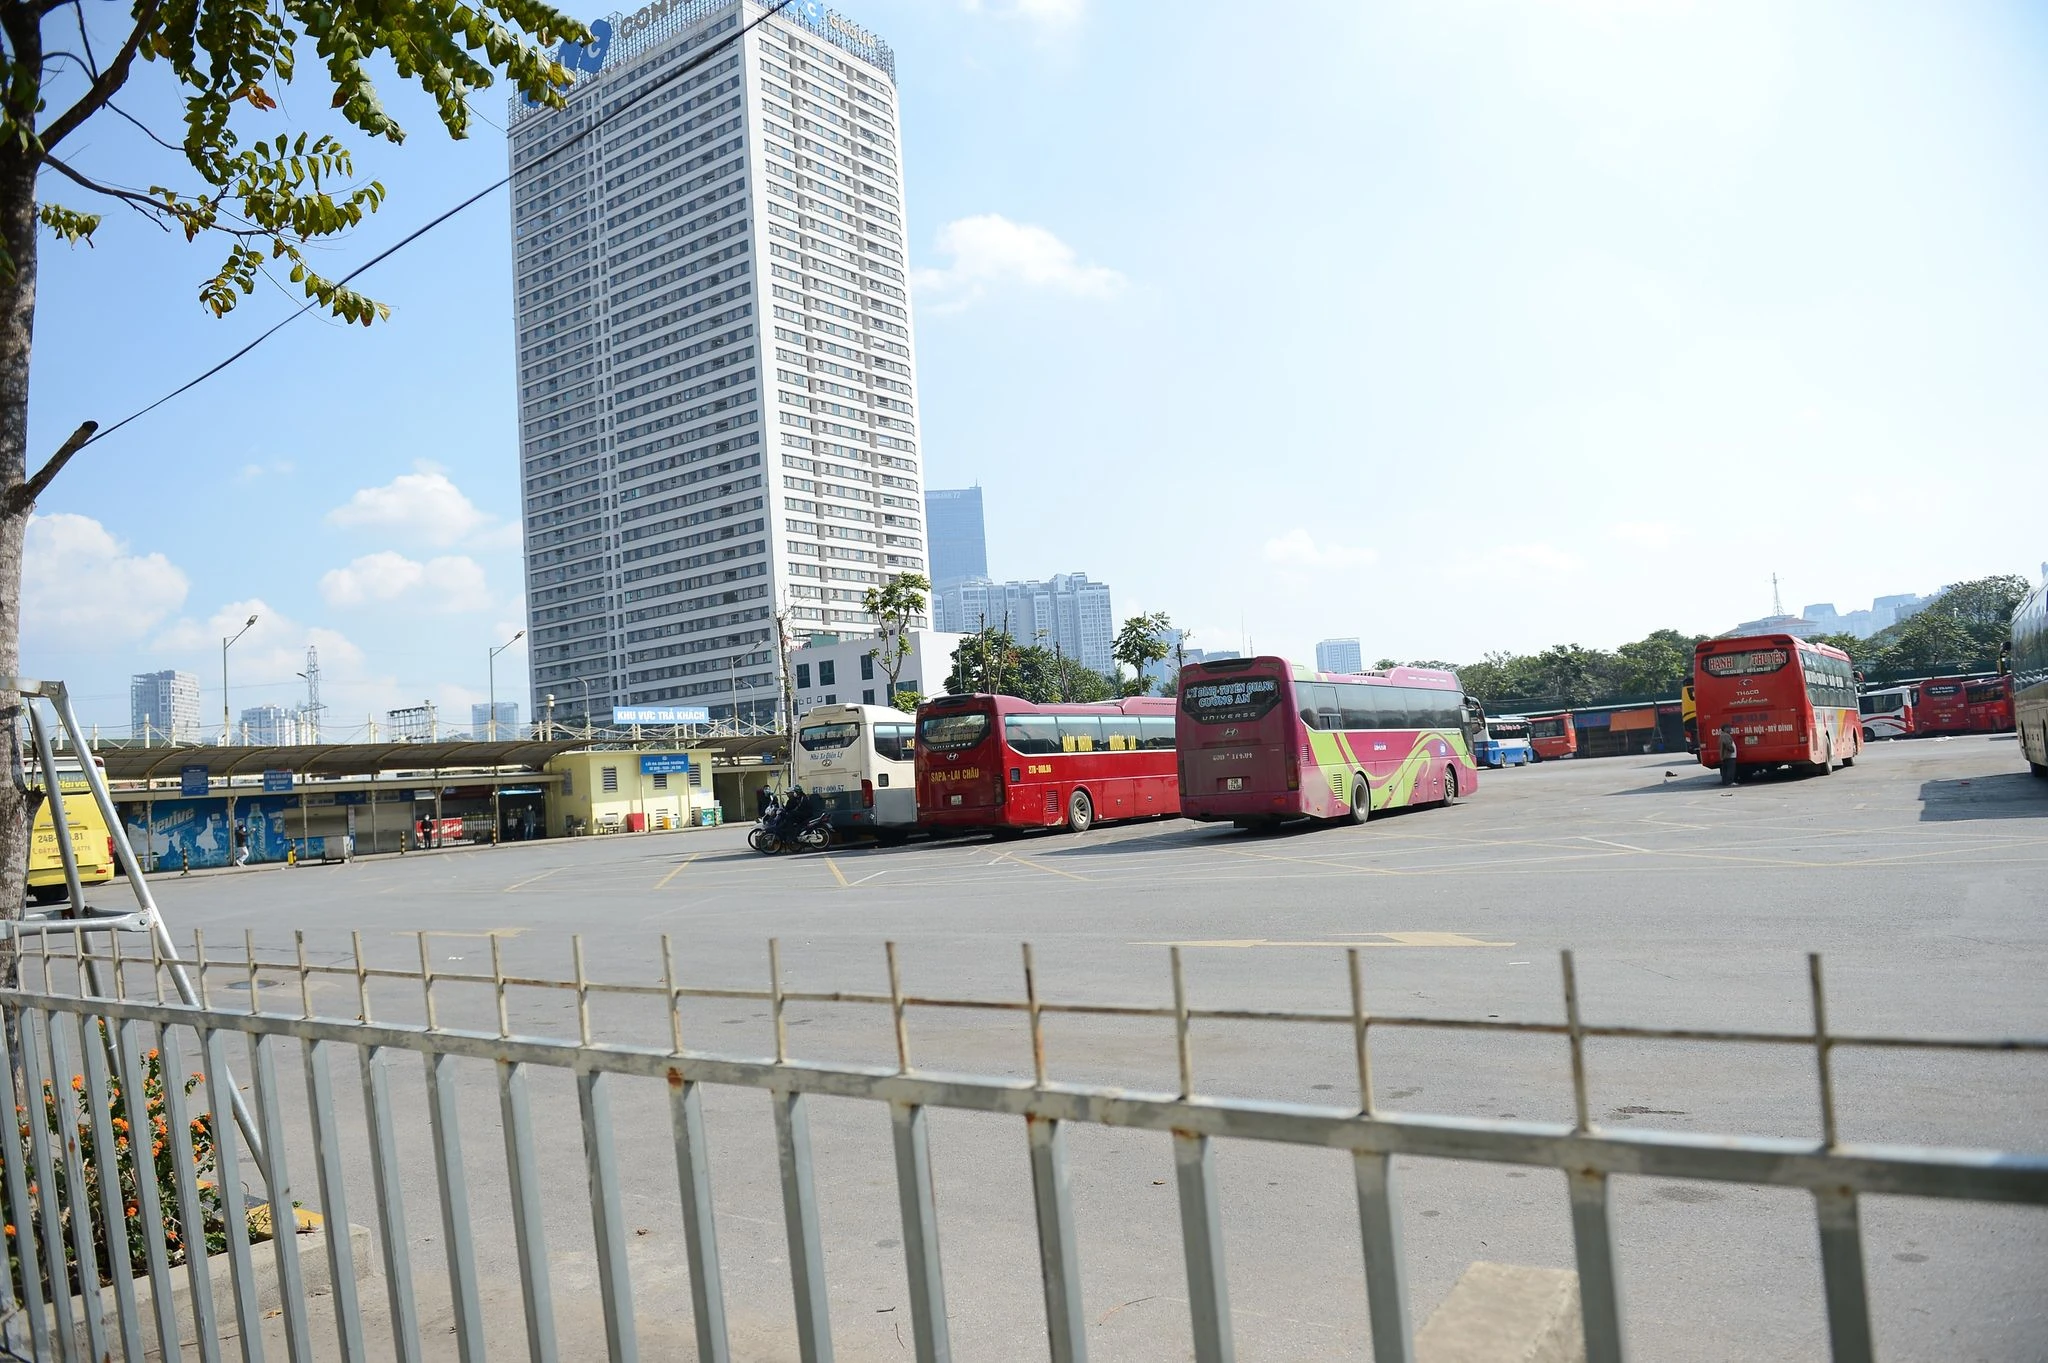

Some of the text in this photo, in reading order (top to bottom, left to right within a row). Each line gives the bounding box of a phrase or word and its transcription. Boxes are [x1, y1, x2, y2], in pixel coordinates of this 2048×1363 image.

[617, 708, 705, 723] KHU VỰC TRẢ KHÁCH
[1202, 712, 1257, 720] UNIVERSE
[931, 771, 946, 783] SAPA
[950, 770, 960, 780] LAI
[962, 766, 980, 780] CHÂU
[58, 780, 92, 789] Haiva
